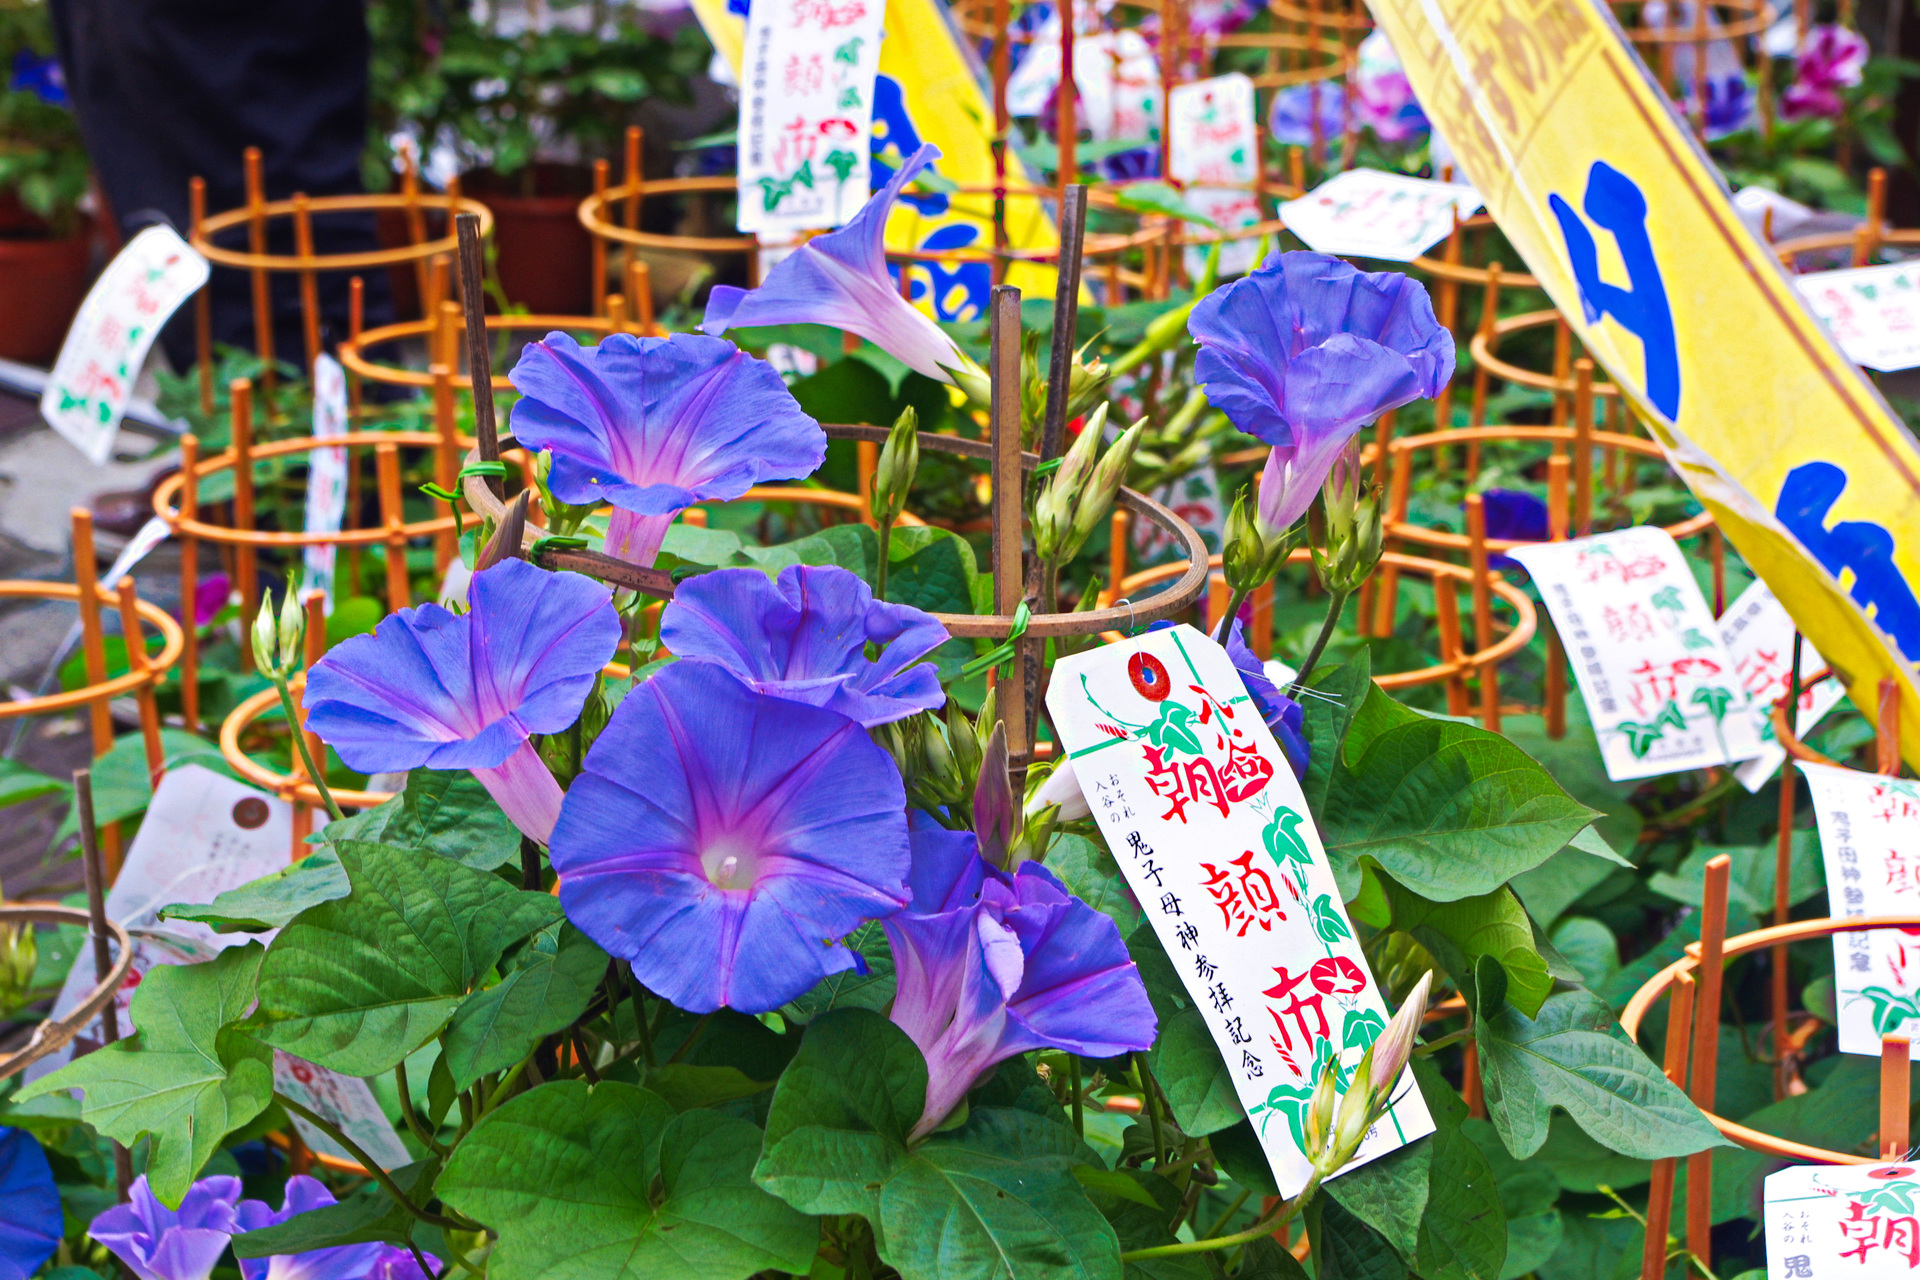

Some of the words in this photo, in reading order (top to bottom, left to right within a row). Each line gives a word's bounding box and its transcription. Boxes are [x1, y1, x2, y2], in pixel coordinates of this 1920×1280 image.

[1095, 780, 1122, 824] 入谷の
[1109, 773, 1136, 819] おそれ
[1141, 744, 1330, 1062] 朝顔市
[1125, 830, 1265, 1081] 鬼子母神参拝記念
[1782, 1212, 1795, 1244] 入谷の
[1800, 1211, 1813, 1244] おそれ
